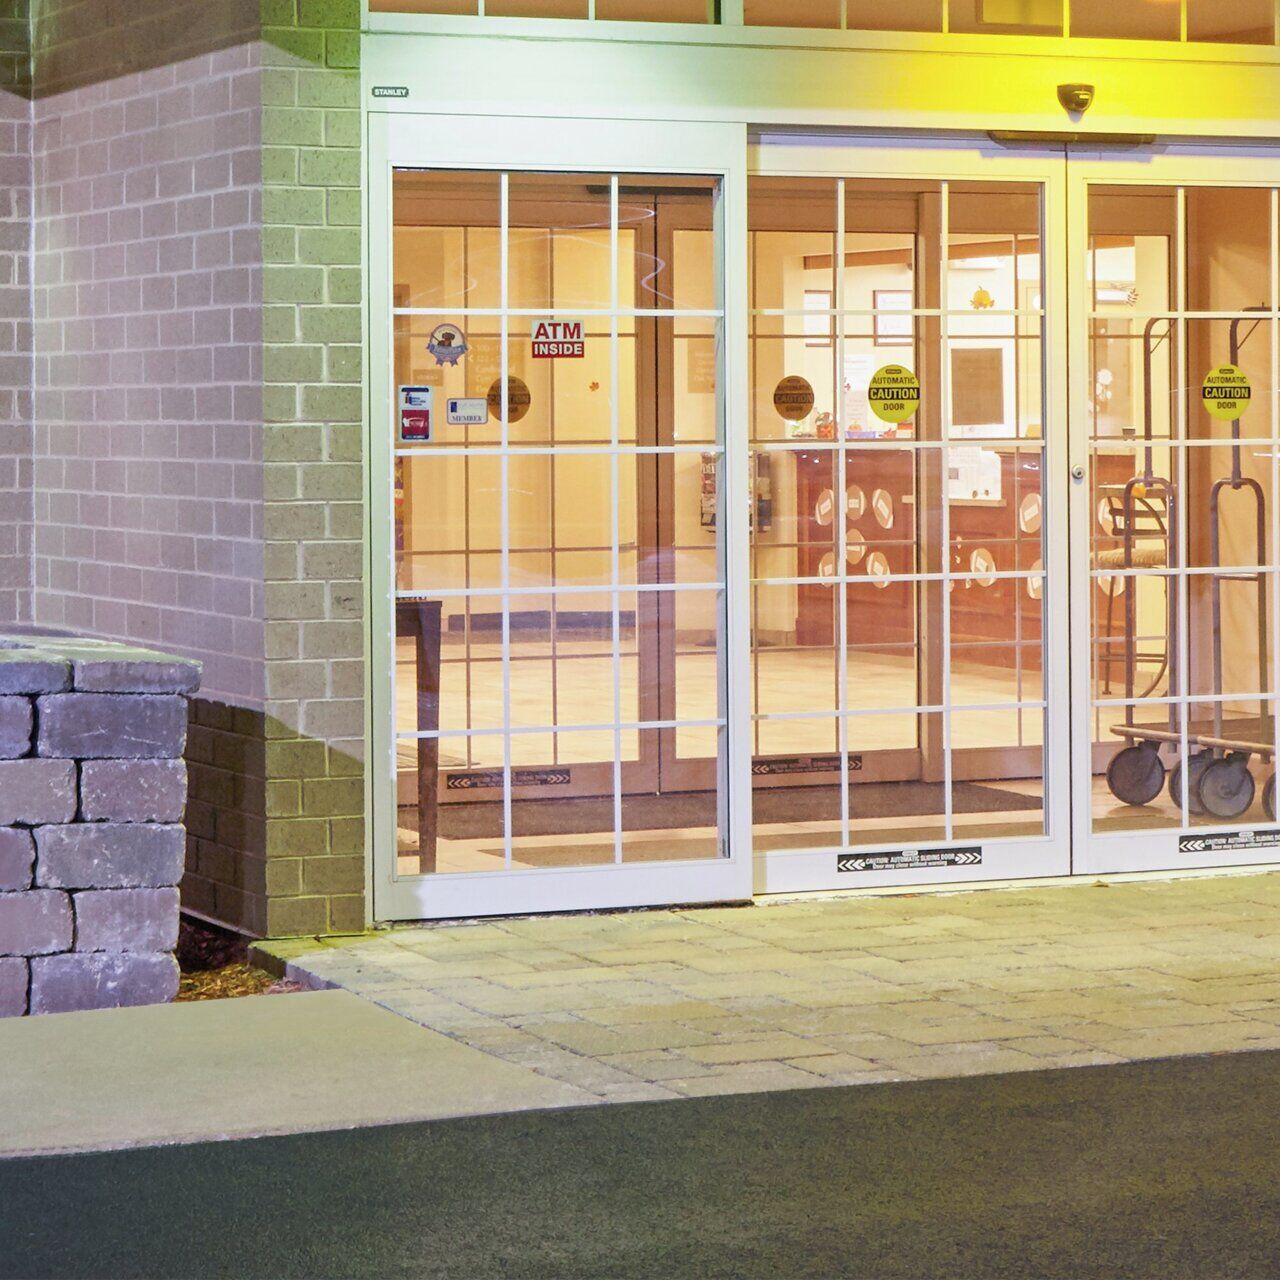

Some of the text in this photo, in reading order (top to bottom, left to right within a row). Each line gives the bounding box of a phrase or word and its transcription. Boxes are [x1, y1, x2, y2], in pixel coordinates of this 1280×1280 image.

[374, 88, 407, 96] STANLEY
[534, 322, 581, 339] ATM
[534, 343, 583, 355] INSIDE
[872, 376, 915, 384] AUTOMATIC
[1206, 376, 1247, 384] AUTOMATIC
[870, 388, 918, 399] CAUTION
[1205, 387, 1249, 398] CAUTION
[883, 403, 905, 411] DOOR
[1216, 401, 1237, 409] DOOR
